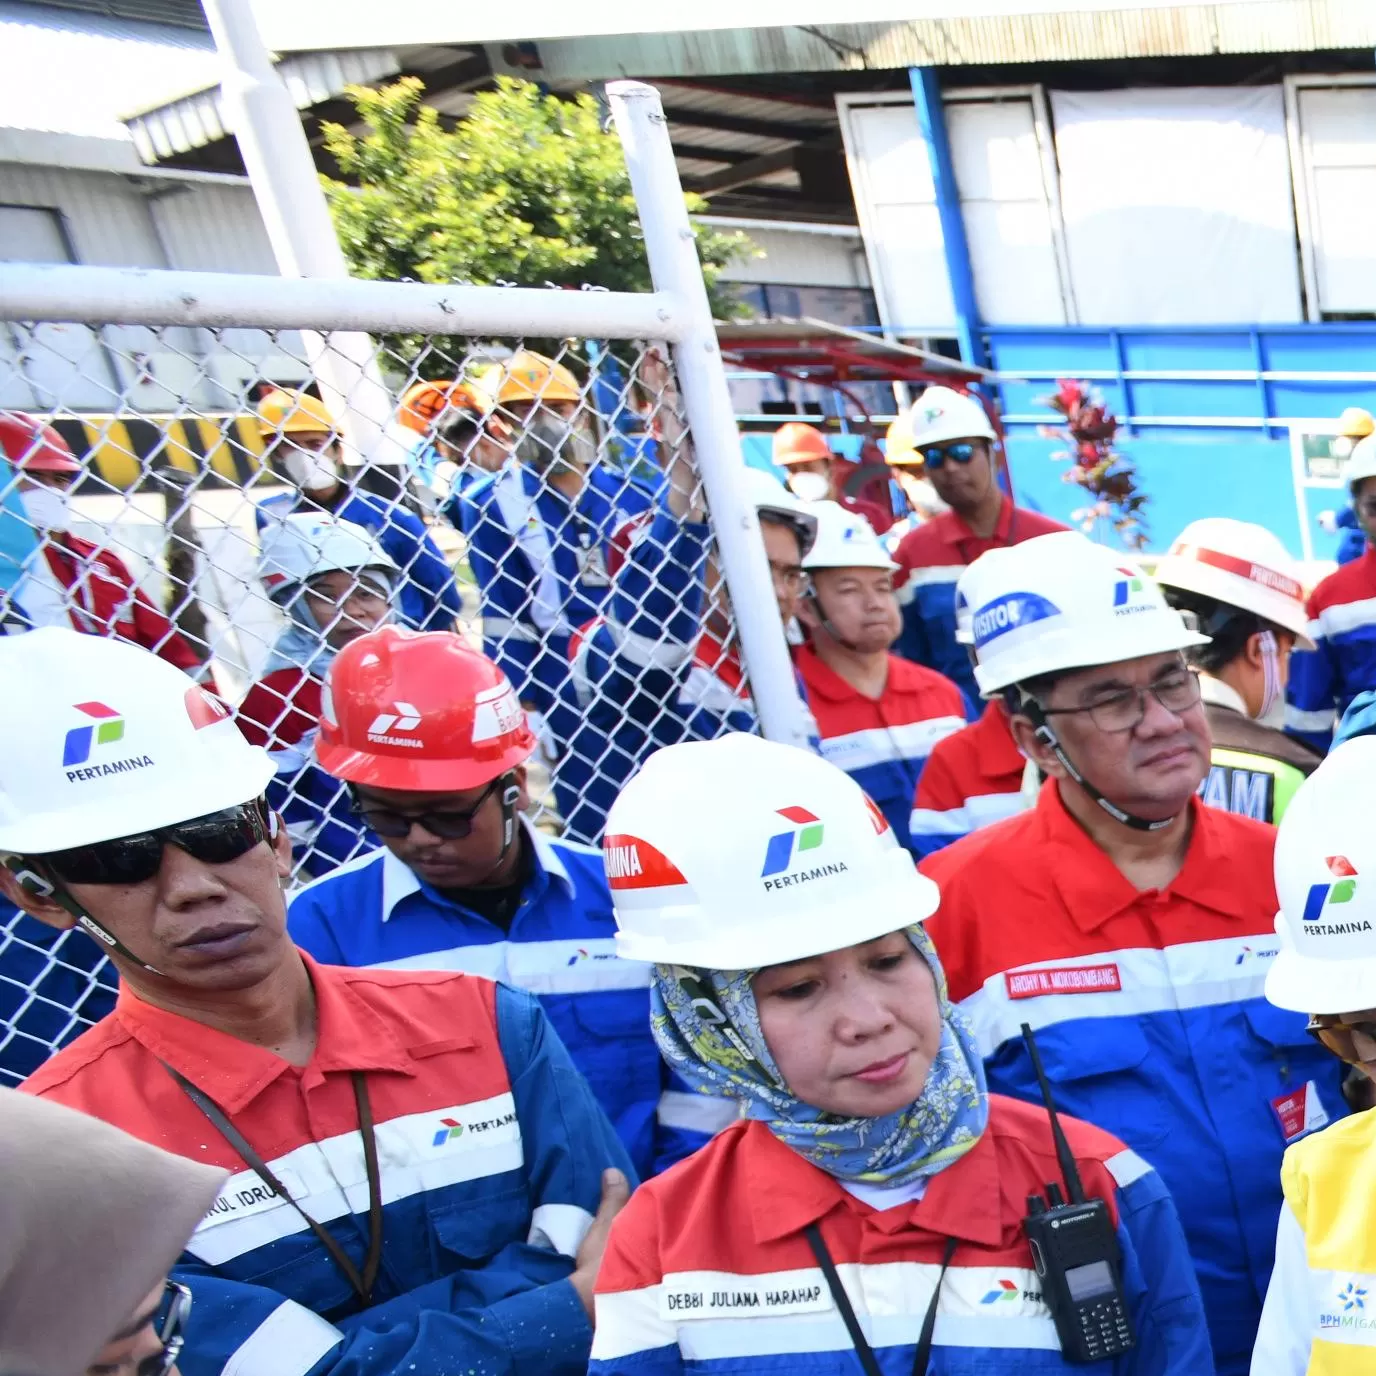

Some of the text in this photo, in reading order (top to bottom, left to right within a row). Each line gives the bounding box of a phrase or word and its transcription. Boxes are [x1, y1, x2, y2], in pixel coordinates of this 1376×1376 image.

[368, 734, 424, 748] PERTAMINA
[68, 755, 155, 783] PERTAMINA
[765, 862, 849, 892] PERTAMINA
[1303, 921, 1372, 936] PERTAMINA
[468, 1113, 516, 1133] PERTAM
[236, 1185, 278, 1207] IDRU
[668, 1286, 820, 1310] DEBBI JULIANA HARAHAP
